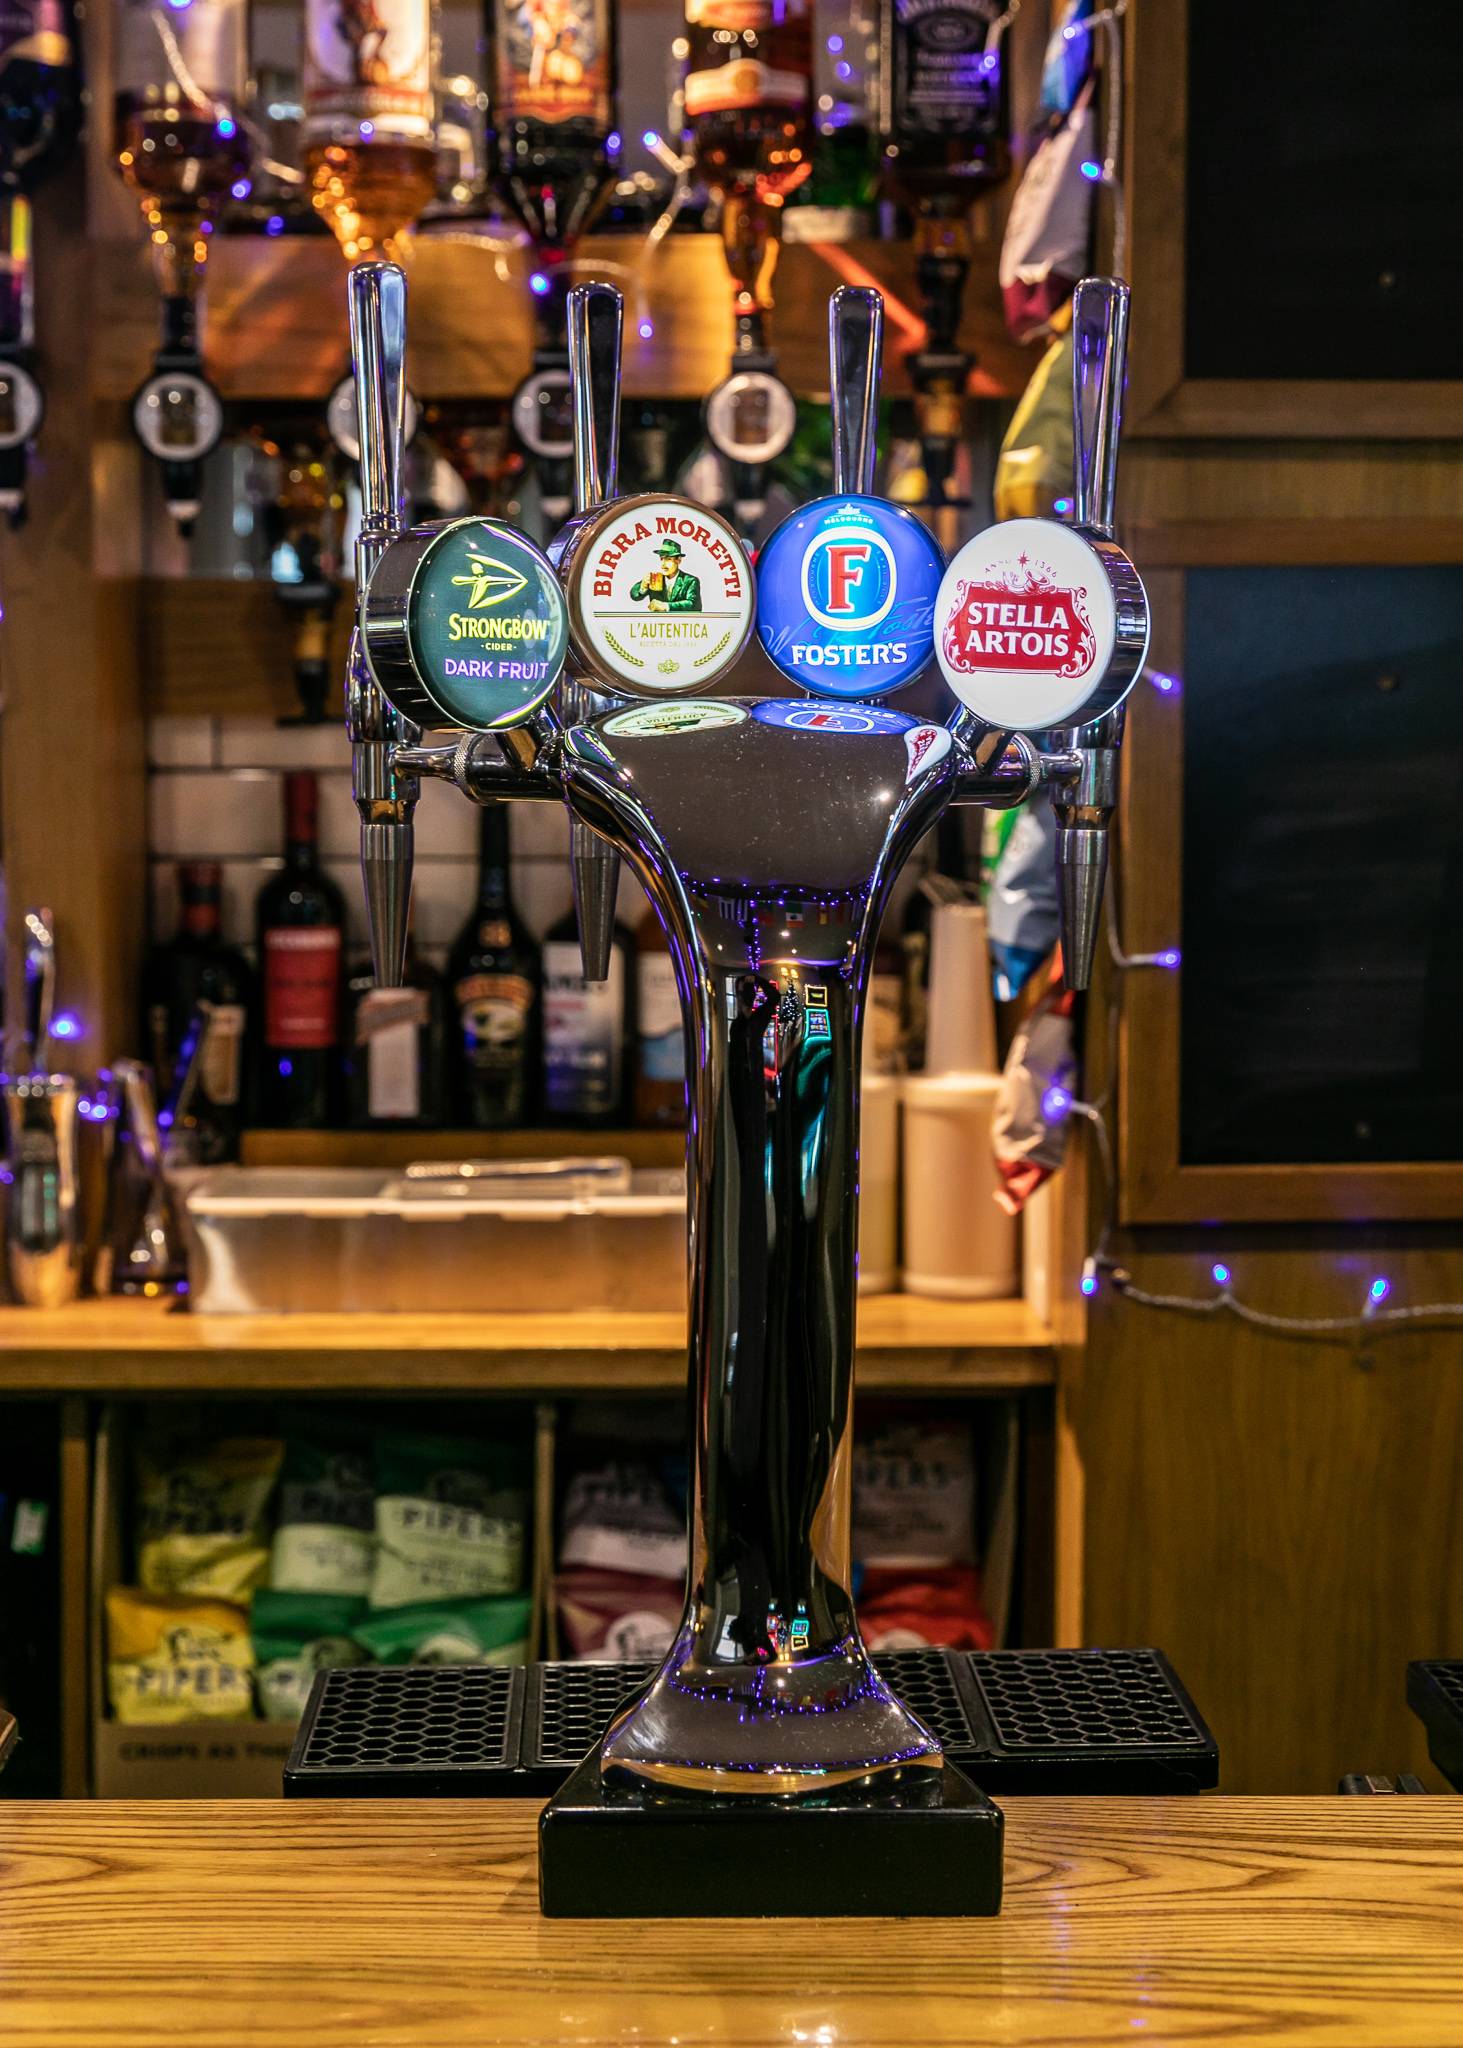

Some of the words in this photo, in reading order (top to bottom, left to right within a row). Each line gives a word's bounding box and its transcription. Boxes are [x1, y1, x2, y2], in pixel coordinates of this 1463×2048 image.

[593, 522, 653, 597] BIRRA
[655, 517, 742, 598] MORETTI
[1034, 559, 1057, 578] 1366
[825, 544, 872, 614] F
[448, 612, 547, 641] STRONGBOW
[967, 601, 1070, 630] STELLA
[629, 622, 708, 639] L'AUTENTICA
[964, 629, 1069, 657] ARTOIS
[485, 642, 513, 651] CIDER
[791, 642, 908, 666] FOSTER'S
[444, 658, 494, 678] DARK
[498, 661, 549, 680] FRUIT
